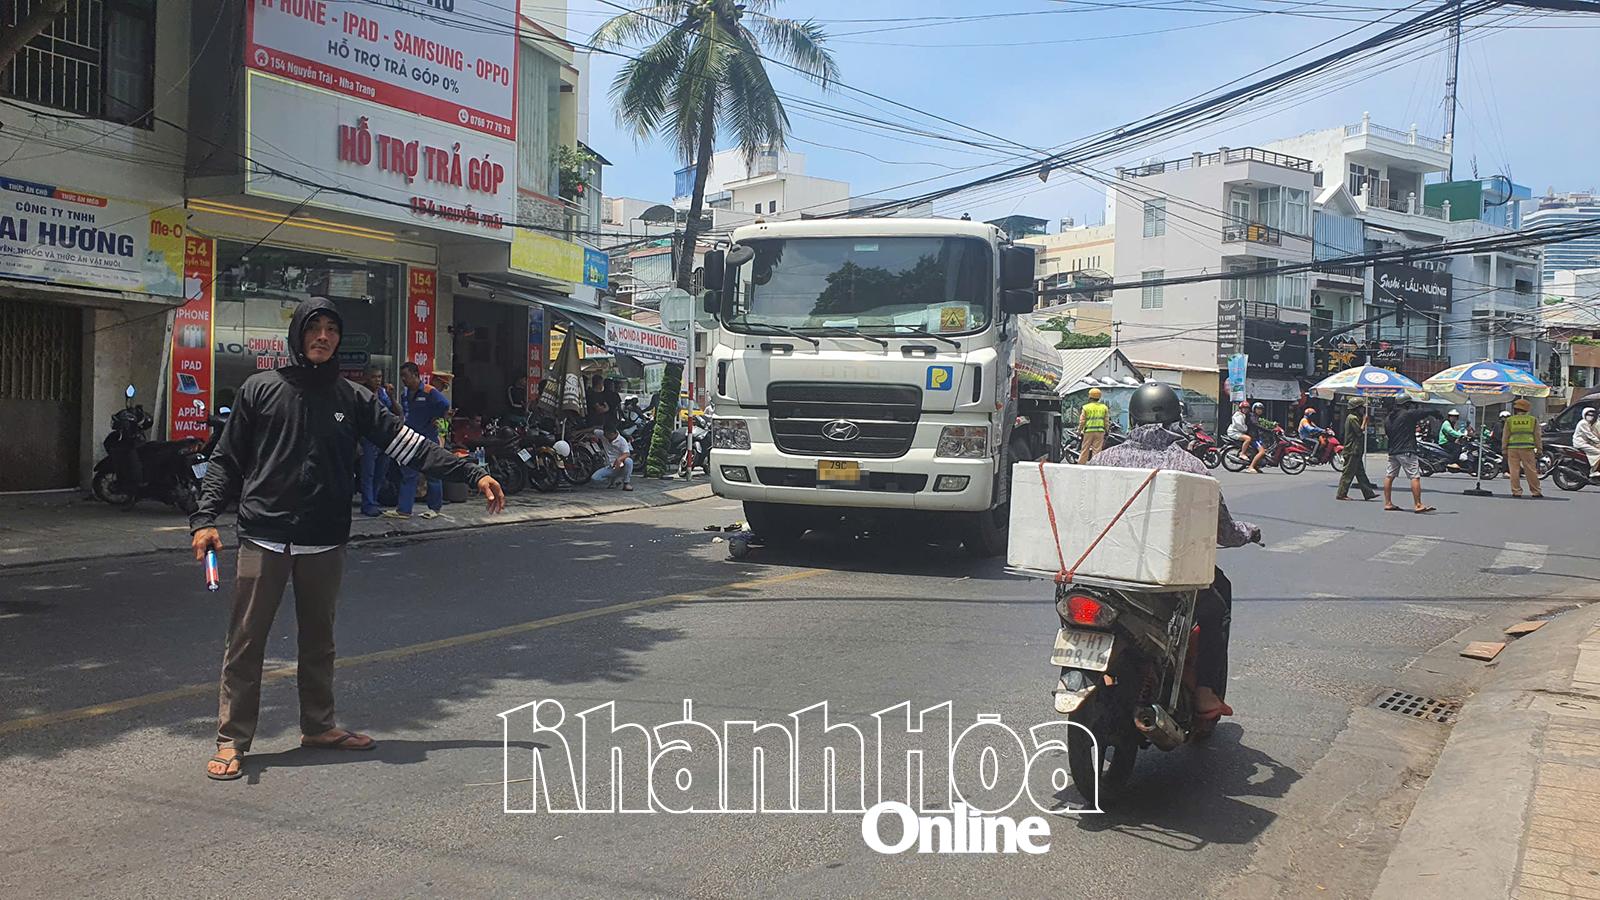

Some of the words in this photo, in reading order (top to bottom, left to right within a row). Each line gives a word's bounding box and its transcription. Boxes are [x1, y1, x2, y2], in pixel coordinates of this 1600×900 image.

[262, 0, 327, 26] HONE
[343, 11, 379, 42] IPAD
[393, 28, 464, 72] SAMSUNG
[476, 57, 509, 87] OPPO
[328, 38, 350, 59] HỖ
[354, 47, 381, 71] TRỢ
[384, 57, 408, 78] TRẢ
[412, 67, 440, 87] GÓP
[443, 79, 460, 94] 0%
[271, 57, 286, 71] 154
[287, 62, 317, 79] Nguyễn
[339, 77, 354, 90] Nha
[356, 81, 376, 97] Trang
[338, 115, 372, 166] HỖ
[377, 134, 420, 184] TRỢ
[424, 142, 463, 188] TRẢ
[468, 153, 505, 194] GÓP
[15, 201, 47, 215] CÔNG
[51, 207, 64, 218] TY
[67, 210, 96, 223] TNHH
[410, 196, 435, 217] 154
[151, 219, 183, 239] Me-O
[38, 221, 134, 258] HƯƠNG
[45, 250, 55, 259] VÀ
[413, 272, 432, 287] 154
[1380, 273, 1401, 289] Sushi
[176, 308, 209, 321] IPHONE
[415, 327, 428, 345] TRẢ
[619, 327, 641, 343] HONDA
[640, 331, 677, 351] PHƯƠNG
[181, 360, 202, 371] IPAD
[414, 350, 428, 366] GÓP
[178, 407, 204, 417] APPLE
[830, 461, 847, 470] 79C
